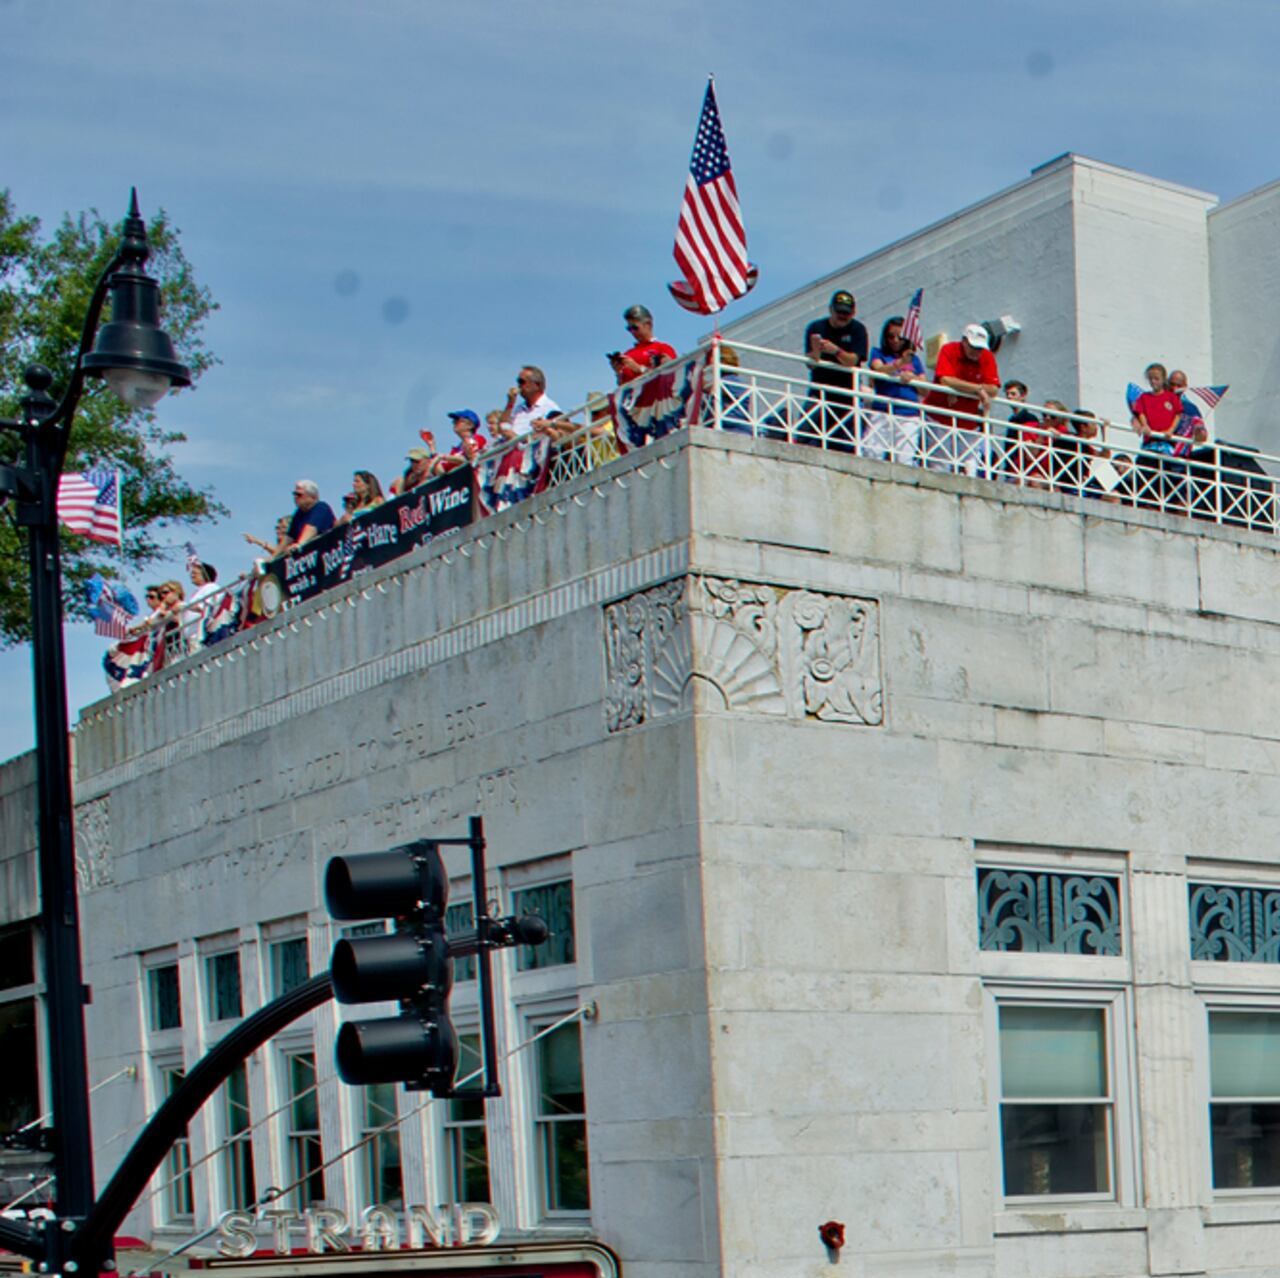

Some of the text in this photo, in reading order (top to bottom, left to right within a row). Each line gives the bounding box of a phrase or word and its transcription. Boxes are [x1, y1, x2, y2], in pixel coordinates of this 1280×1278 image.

[429, 486, 470, 517] Wine
[367, 523, 398, 548] Hare
[285, 550, 318, 580] Brew
[216, 1201, 501, 1258] STRAND
